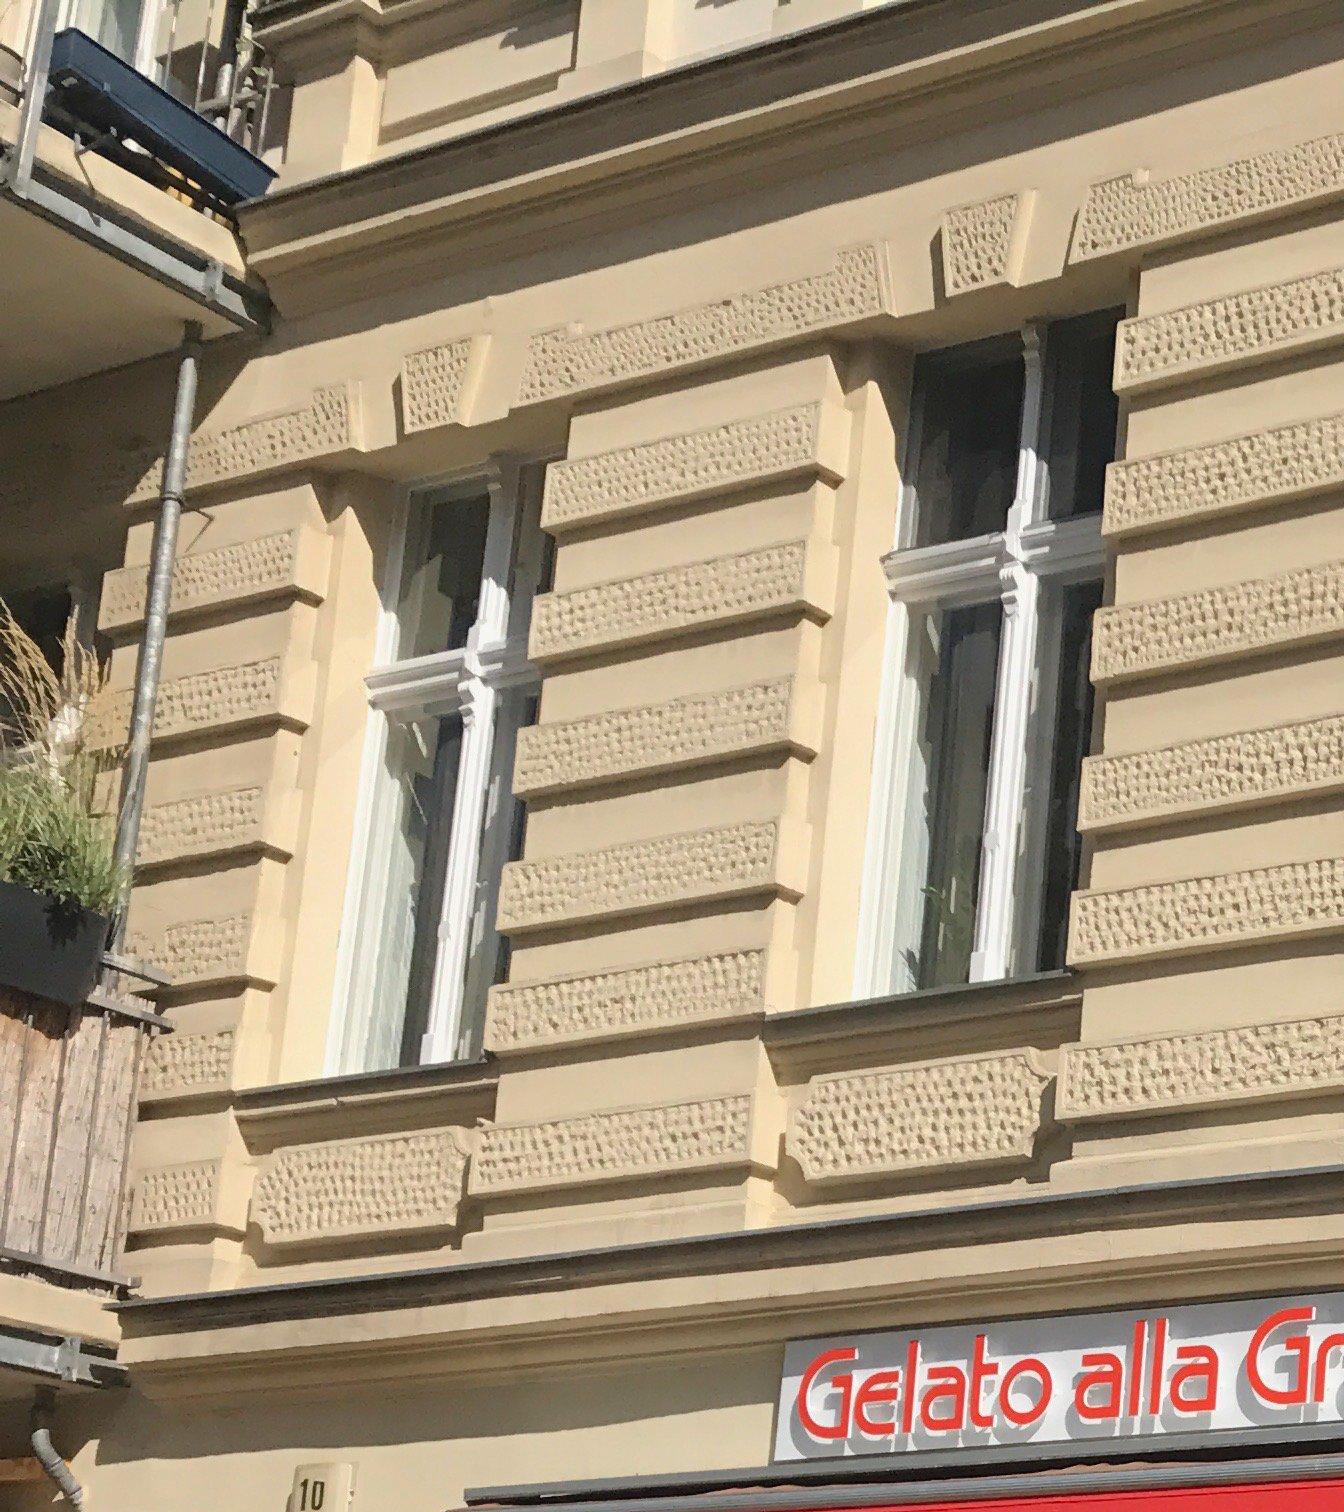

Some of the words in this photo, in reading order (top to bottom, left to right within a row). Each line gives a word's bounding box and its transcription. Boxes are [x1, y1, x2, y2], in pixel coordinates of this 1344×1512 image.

[797, 1335, 1052, 1440] Gelato
[1074, 1317, 1219, 1420] alla
[300, 1478, 324, 1511] 10
